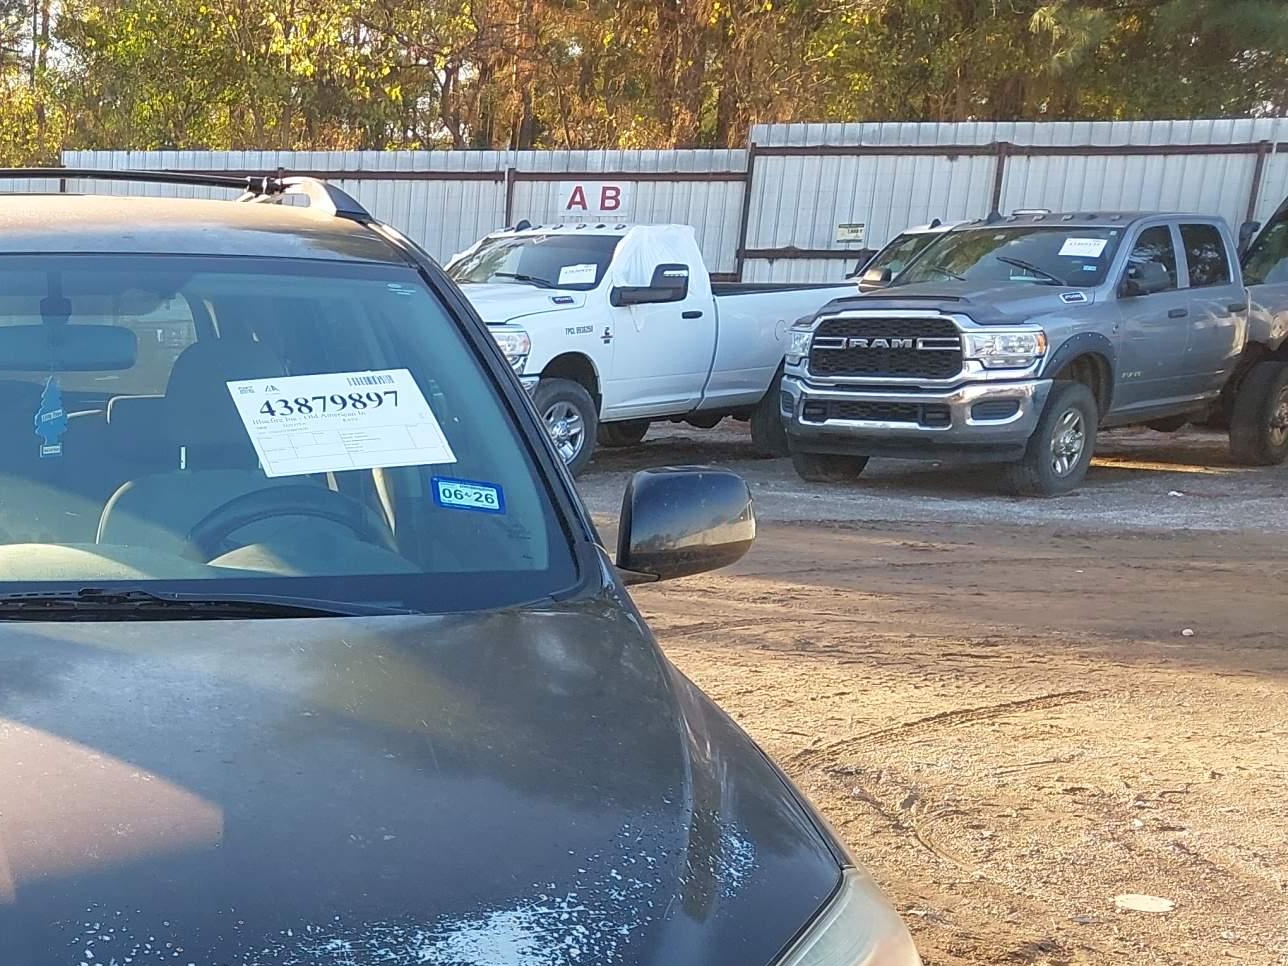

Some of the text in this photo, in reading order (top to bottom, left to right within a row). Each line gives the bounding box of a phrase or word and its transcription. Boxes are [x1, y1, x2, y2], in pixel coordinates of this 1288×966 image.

[566, 186, 621, 211] A B
[848, 338, 913, 349] RAM
[259, 390, 398, 417] 43879897
